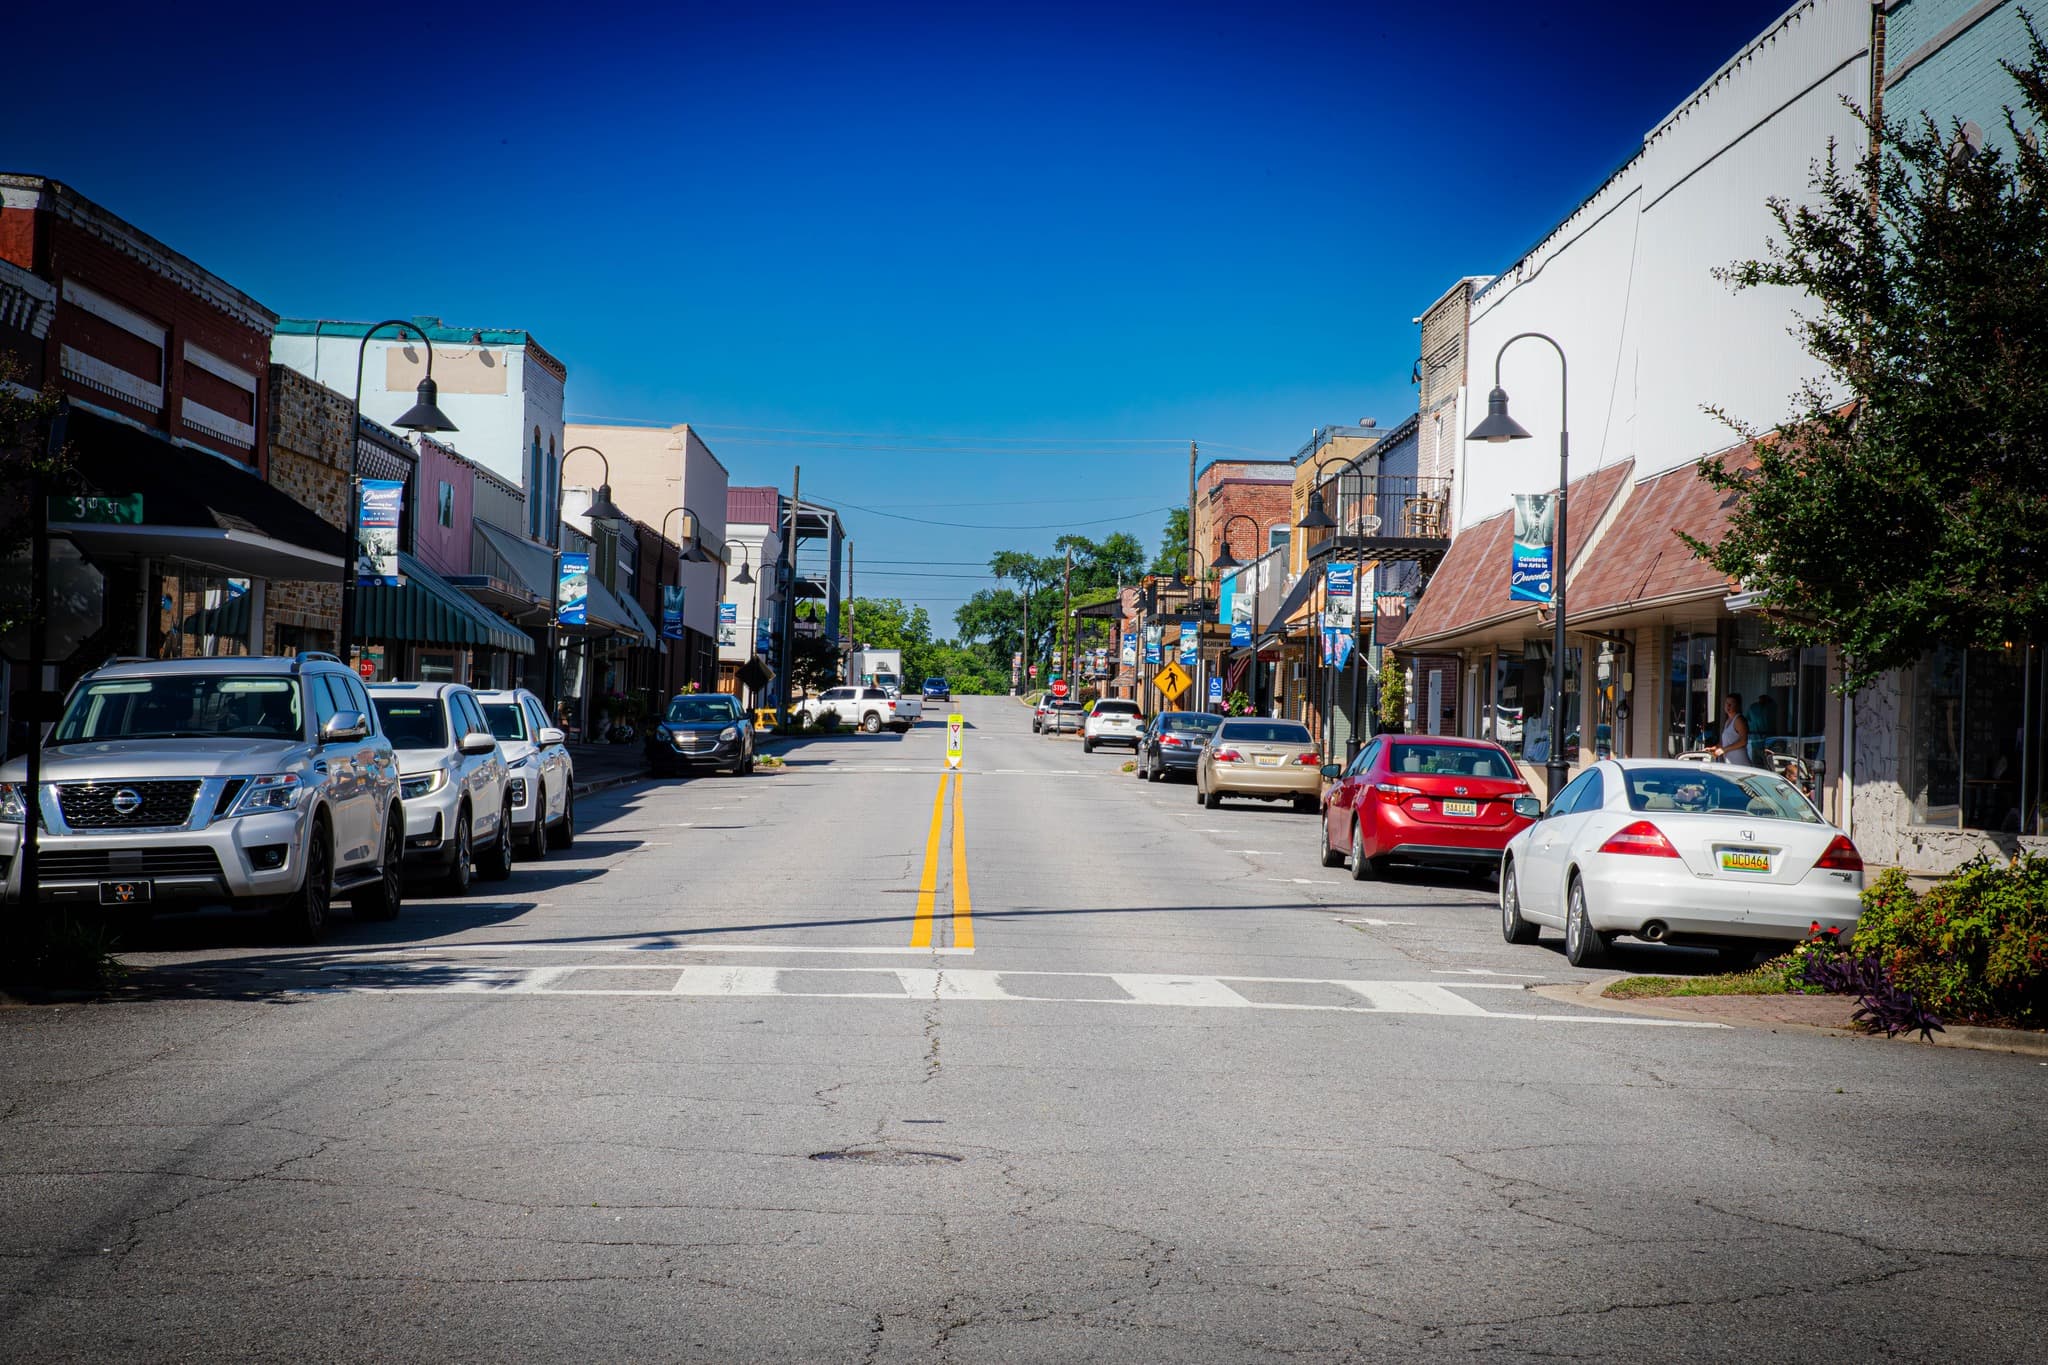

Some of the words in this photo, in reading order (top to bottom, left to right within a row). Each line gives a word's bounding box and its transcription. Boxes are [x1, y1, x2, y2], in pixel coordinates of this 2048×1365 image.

[74, 496, 98, 518] 3RD
[108, 502, 119, 514] ST
[1512, 570, 1551, 584] Oneonta
